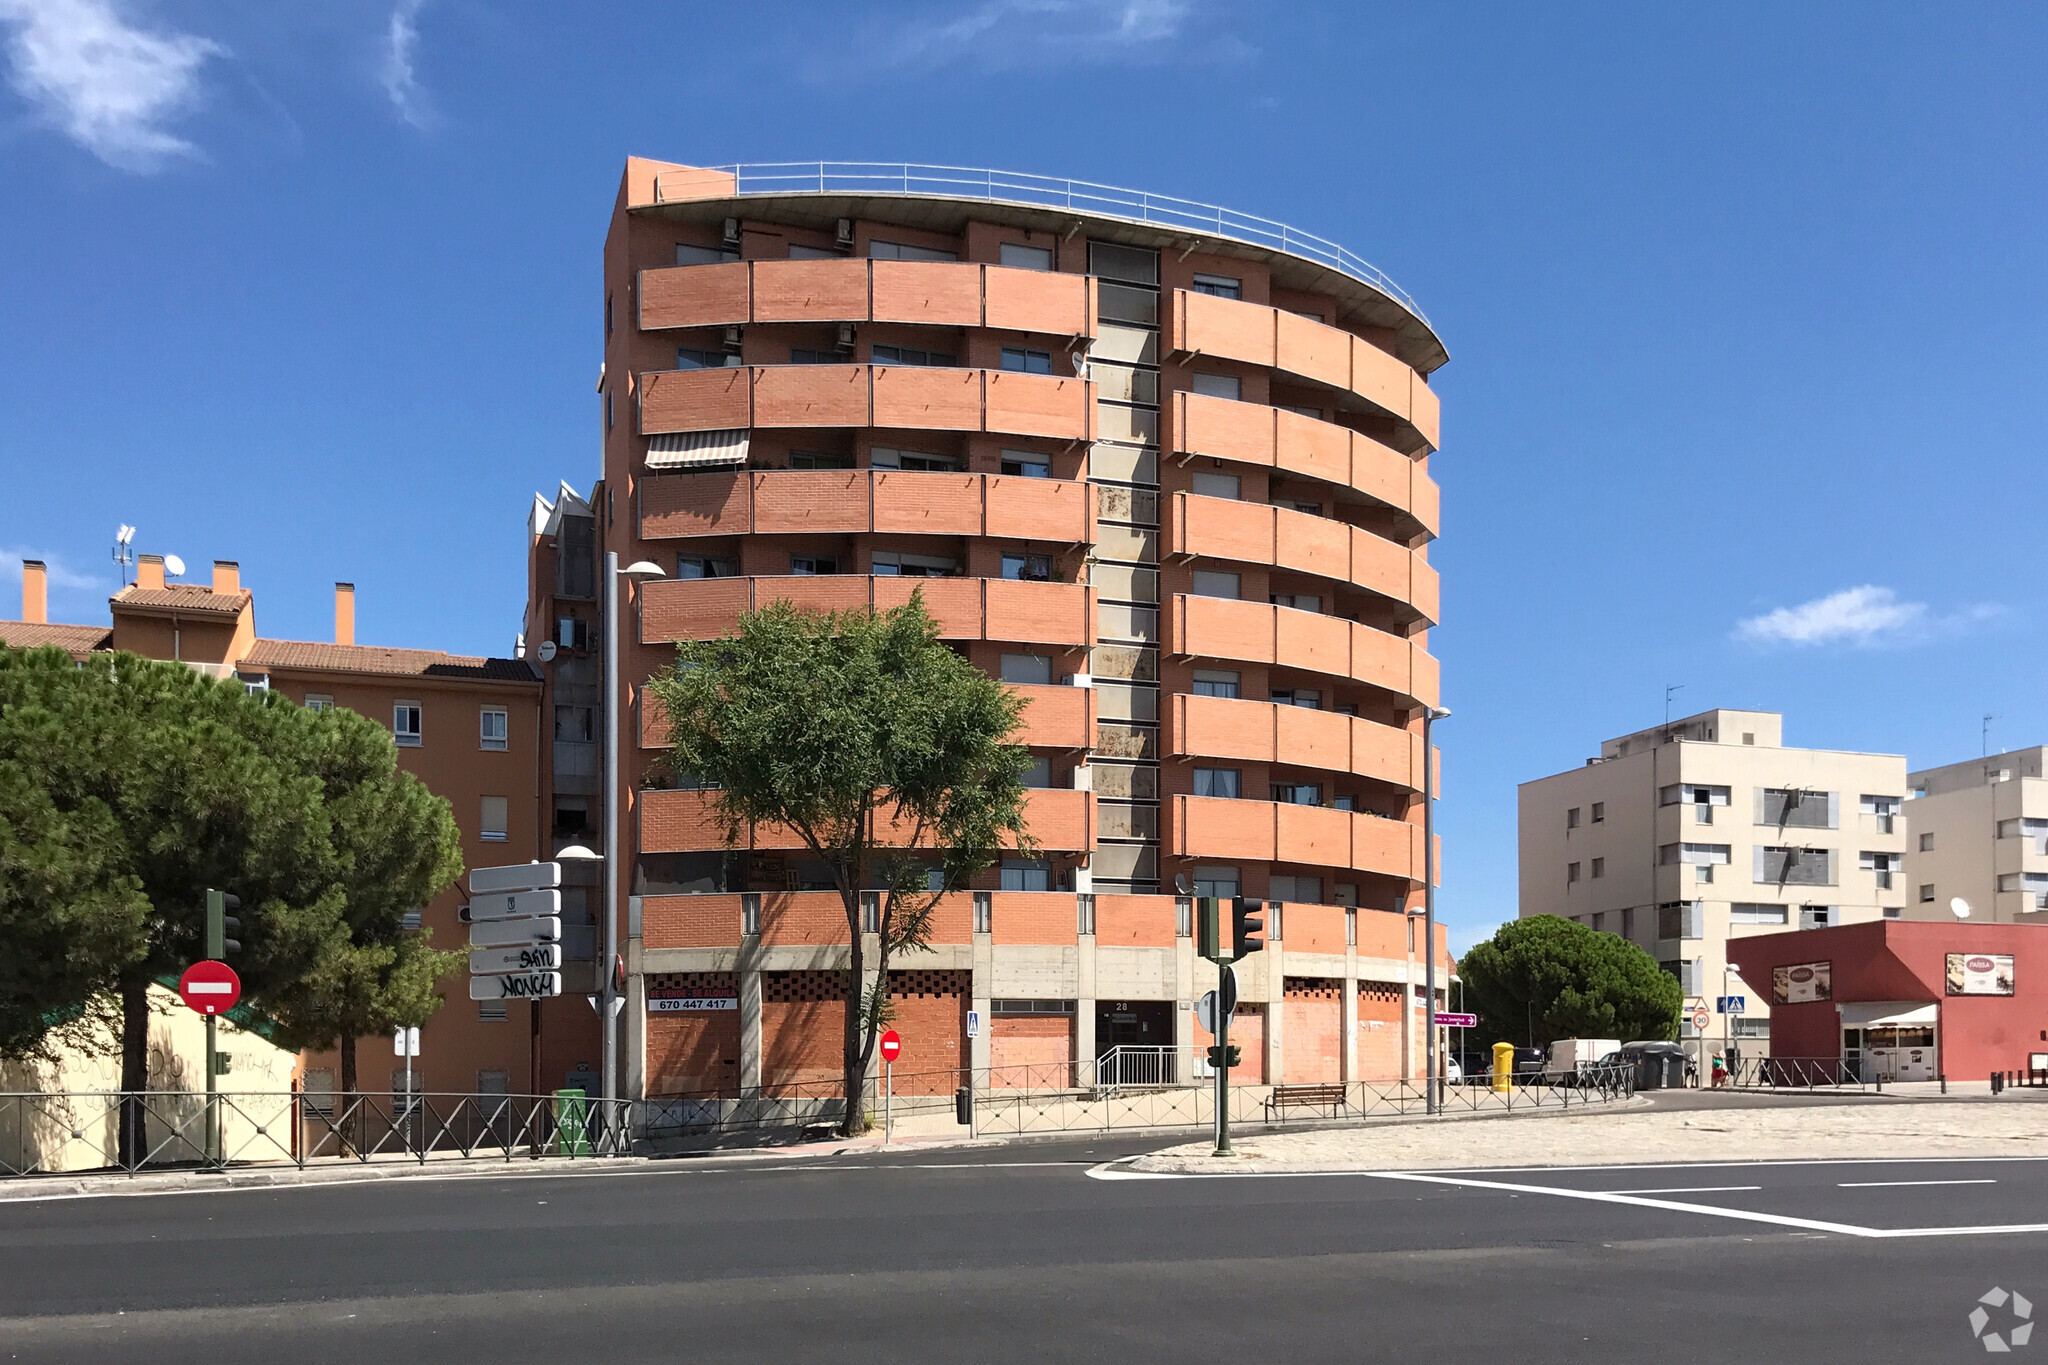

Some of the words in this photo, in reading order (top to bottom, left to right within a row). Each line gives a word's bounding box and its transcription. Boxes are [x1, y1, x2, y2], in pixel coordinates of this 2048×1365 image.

[662, 989, 687, 998] VENDE
[704, 988, 736, 997] ALQUILA
[660, 1000, 680, 1009] 670
[683, 1000, 703, 1009] 447
[706, 1000, 727, 1009] 417
[1116, 1003, 1128, 1011] 28
